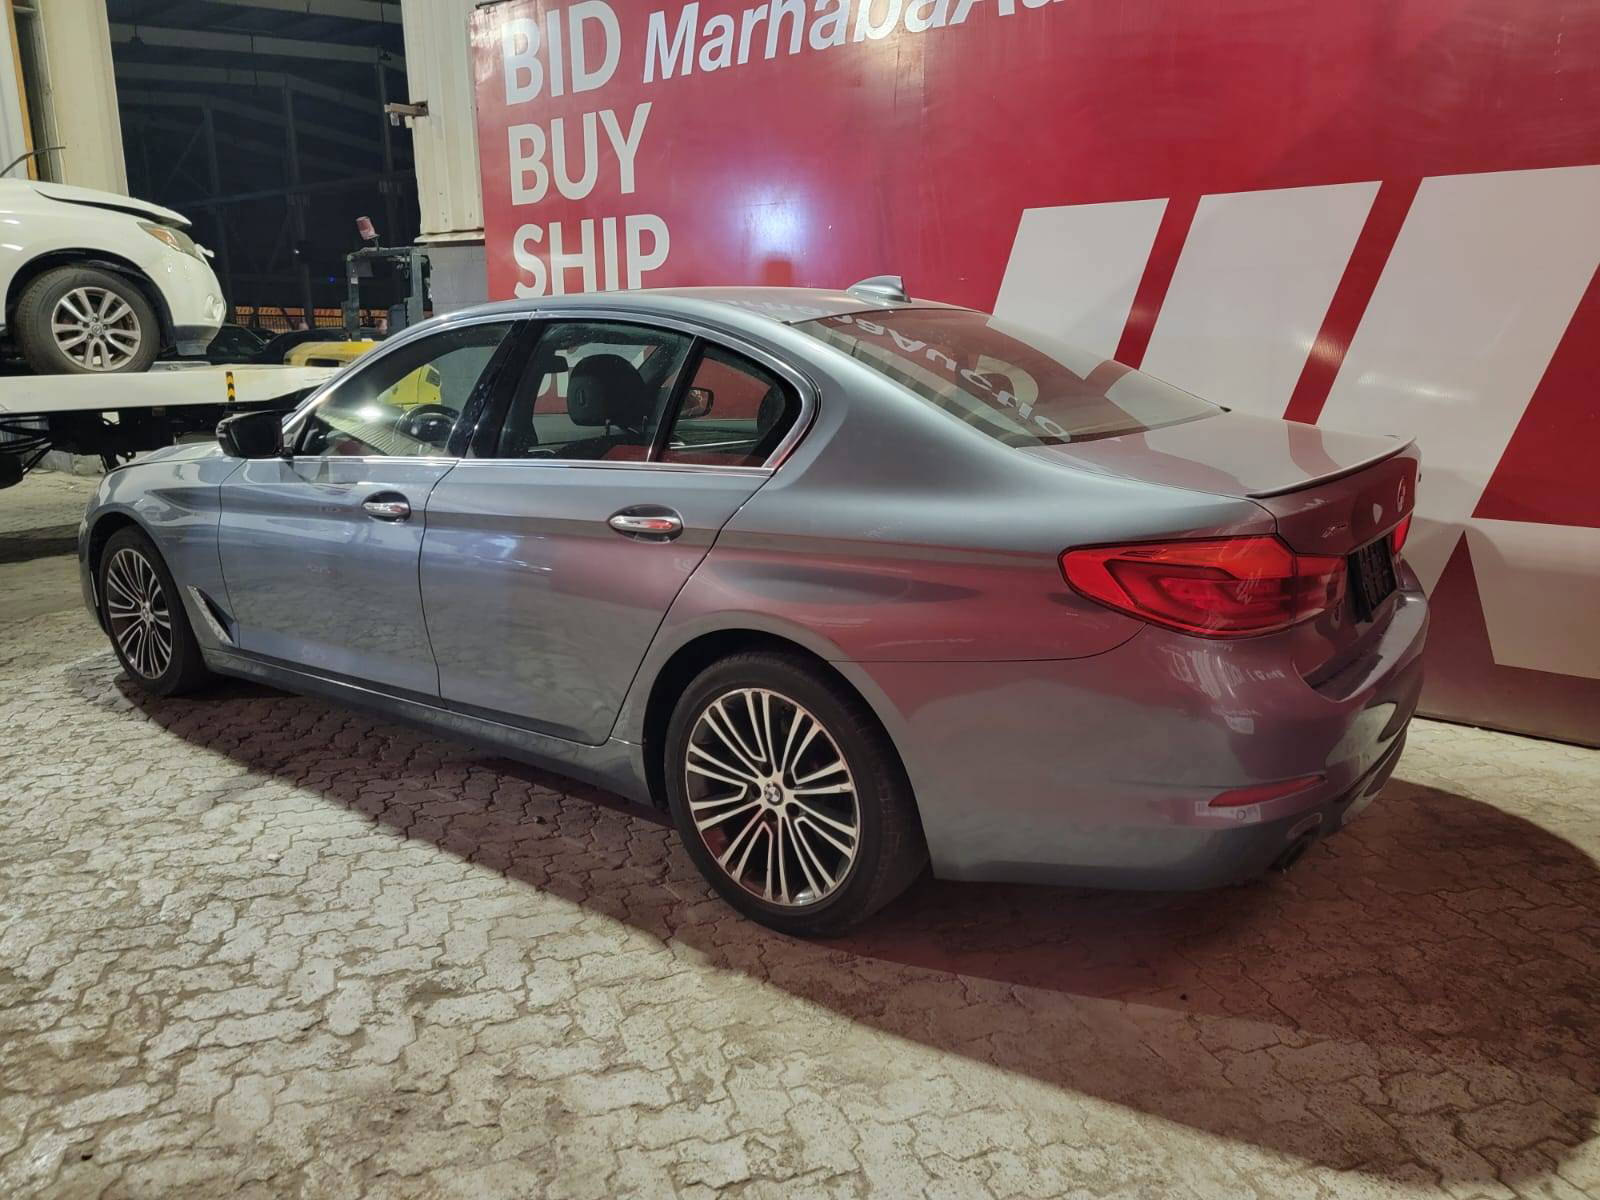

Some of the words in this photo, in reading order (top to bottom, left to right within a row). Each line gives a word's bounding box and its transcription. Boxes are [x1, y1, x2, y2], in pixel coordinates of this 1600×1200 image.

[502, 1, 621, 105] BID
[643, 0, 1067, 84] Marhaba
[507, 102, 652, 206] BUY
[513, 214, 670, 299] SHIP
